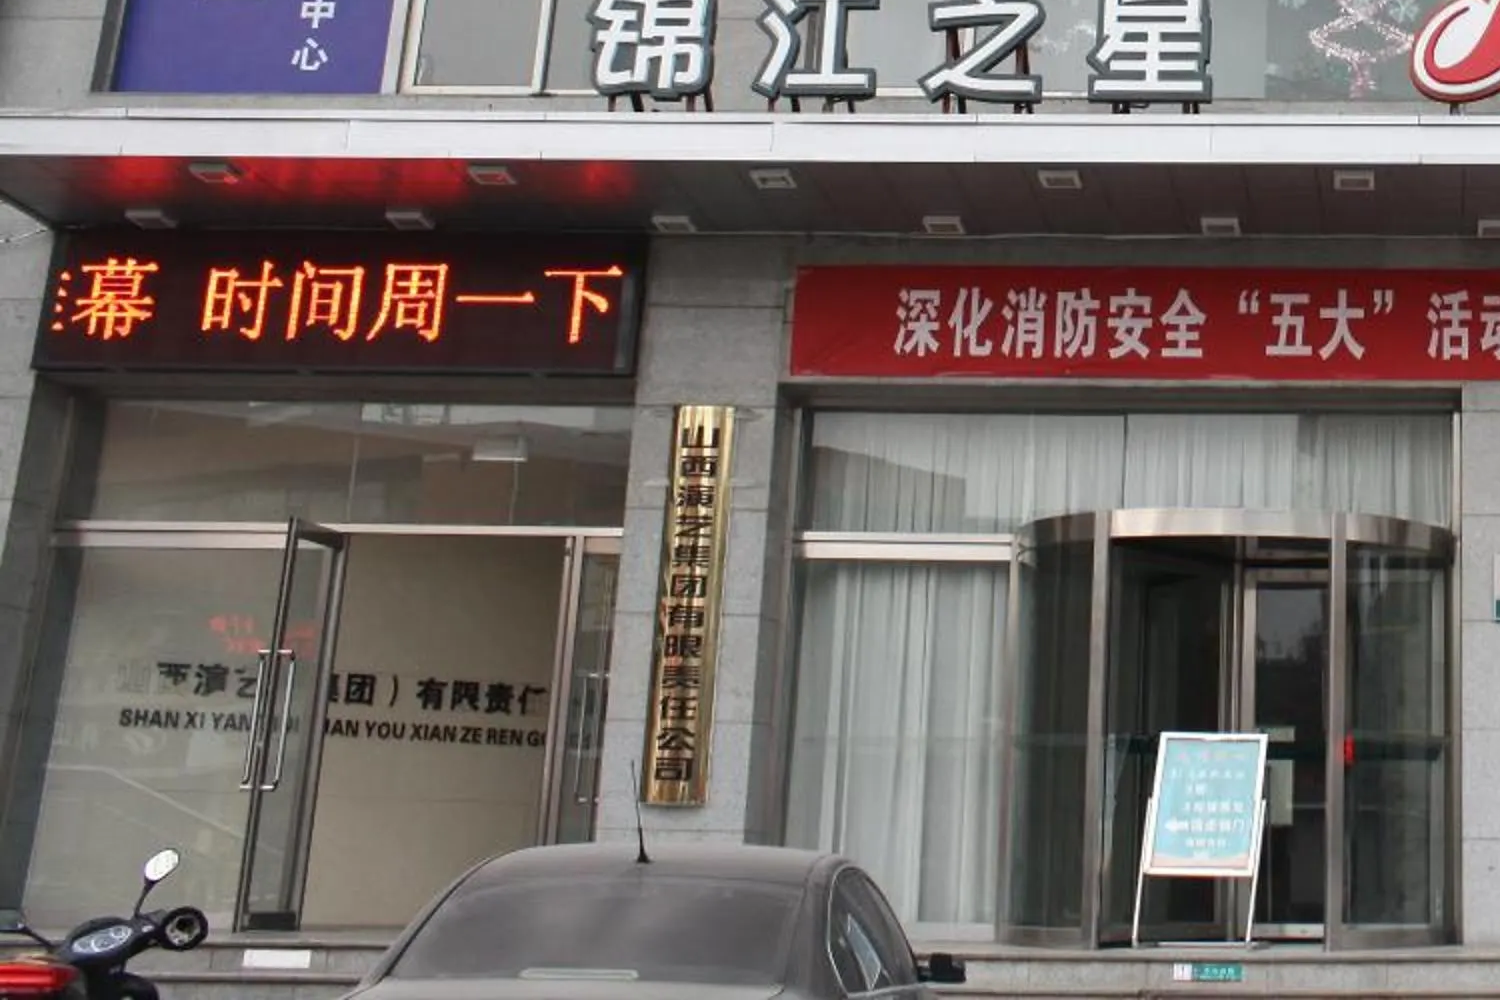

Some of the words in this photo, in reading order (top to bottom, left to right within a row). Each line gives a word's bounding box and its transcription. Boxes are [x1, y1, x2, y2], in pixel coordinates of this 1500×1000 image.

[52, 258, 159, 340] 幕
[200, 260, 622, 344] 时间周一下
[119, 708, 179, 729] SHAN
[184, 711, 206, 729] XI
[364, 720, 406, 741] YOU
[409, 723, 458, 742] XIAN
[459, 727, 483, 744] ZE
[486, 729, 523, 746] REN
